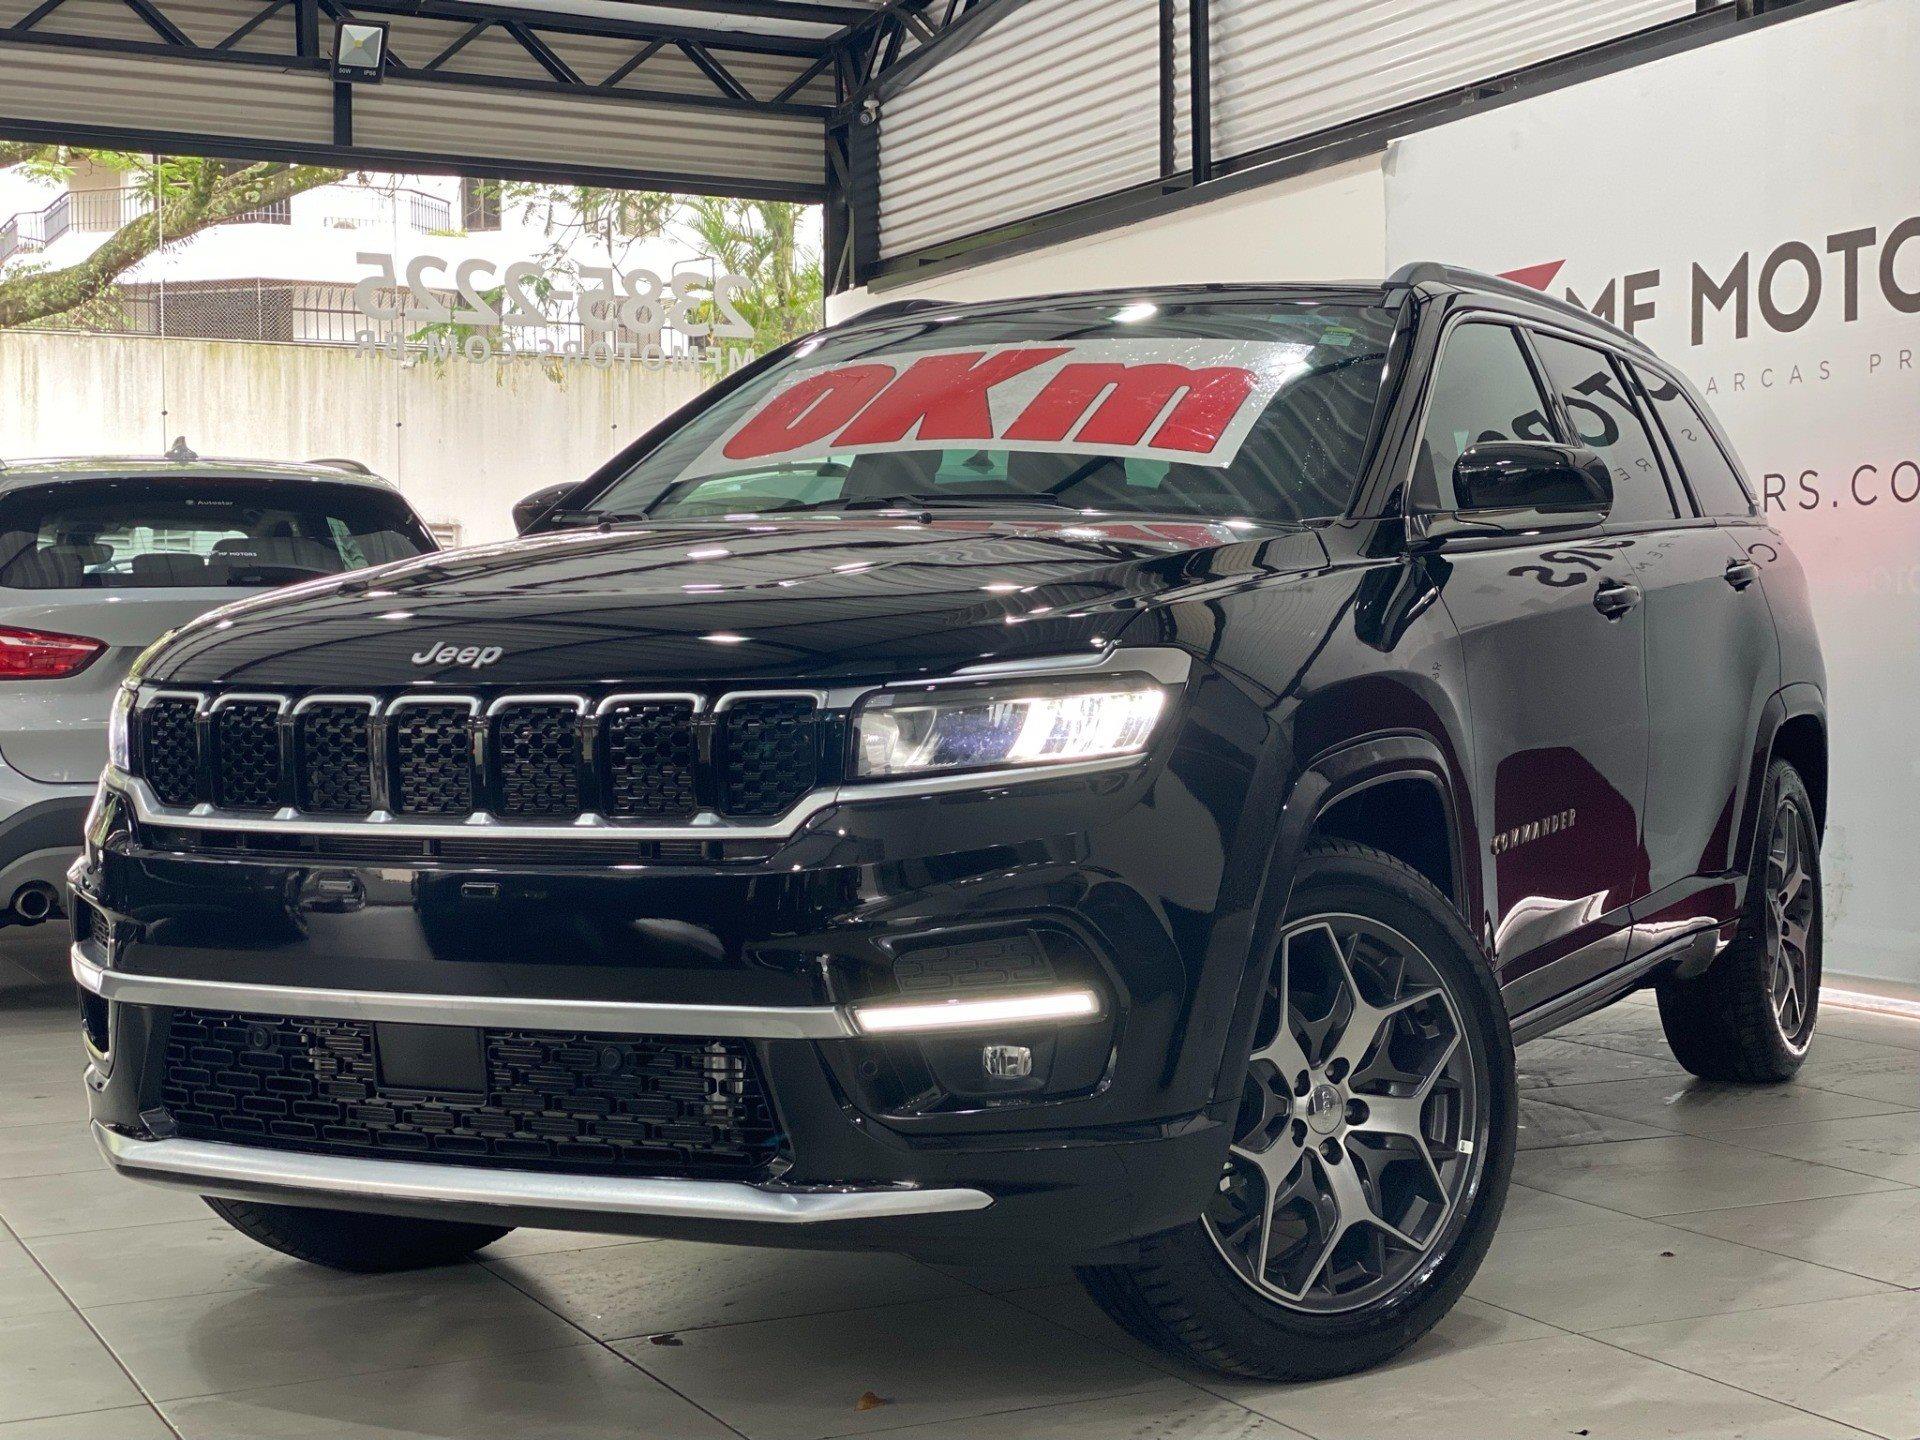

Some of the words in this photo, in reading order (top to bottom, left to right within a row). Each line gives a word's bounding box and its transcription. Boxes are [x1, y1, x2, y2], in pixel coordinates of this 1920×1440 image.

[1705, 360, 1831, 396] ARCAS
[411, 641, 504, 669] Jeep
[1490, 808, 1576, 855] COMMANDER
